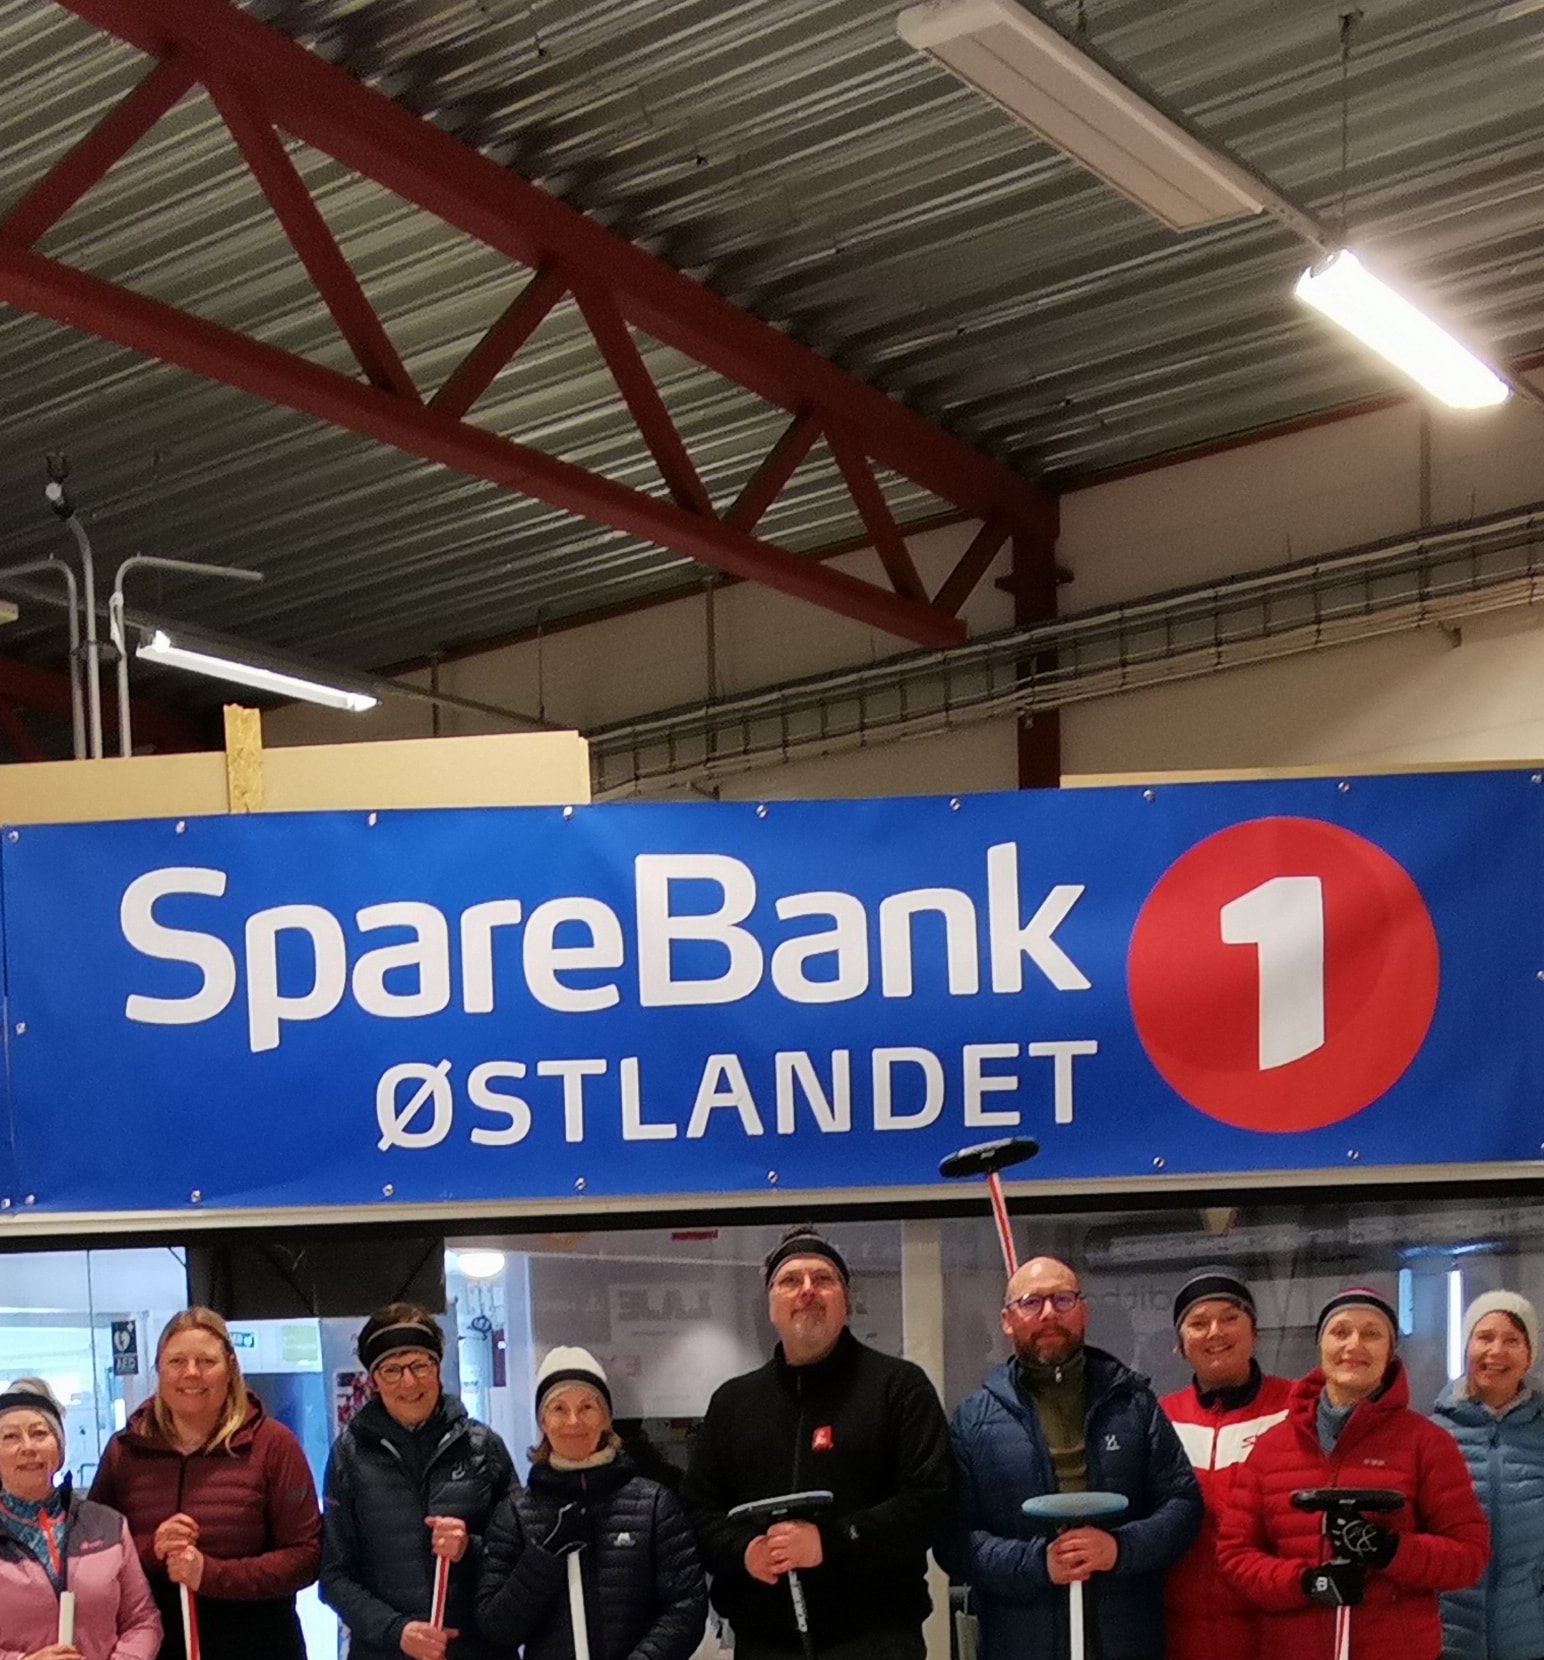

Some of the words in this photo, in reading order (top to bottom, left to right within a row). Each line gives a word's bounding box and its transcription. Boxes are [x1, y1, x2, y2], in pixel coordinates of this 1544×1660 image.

[121, 840, 1093, 1054] SpareBank
[1219, 874, 1326, 1072] 1
[375, 1038, 1101, 1153] ØSTLANDET
